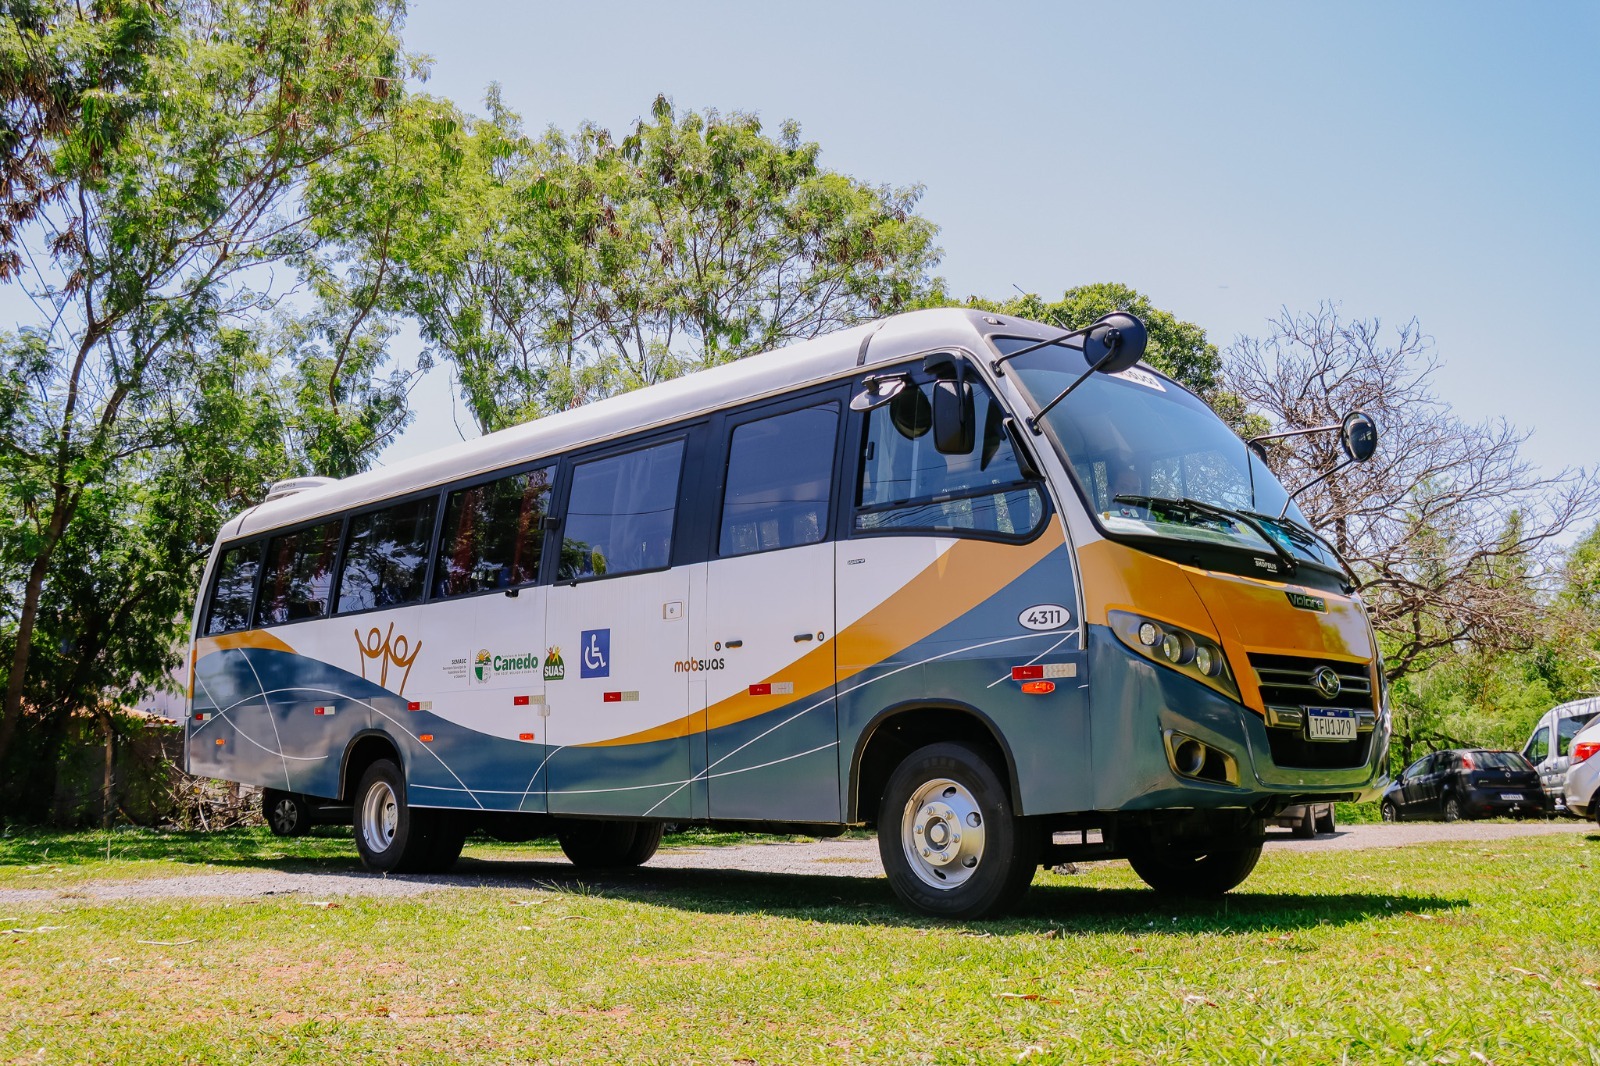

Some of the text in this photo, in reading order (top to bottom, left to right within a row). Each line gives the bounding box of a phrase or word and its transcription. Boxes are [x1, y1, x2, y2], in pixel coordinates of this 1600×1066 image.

[1289, 593, 1324, 611] Volare
[1027, 610, 1061, 625] 4311
[493, 653, 539, 671] Canedo
[674, 656, 725, 673] mobsuas
[544, 665, 564, 677] SUAS
